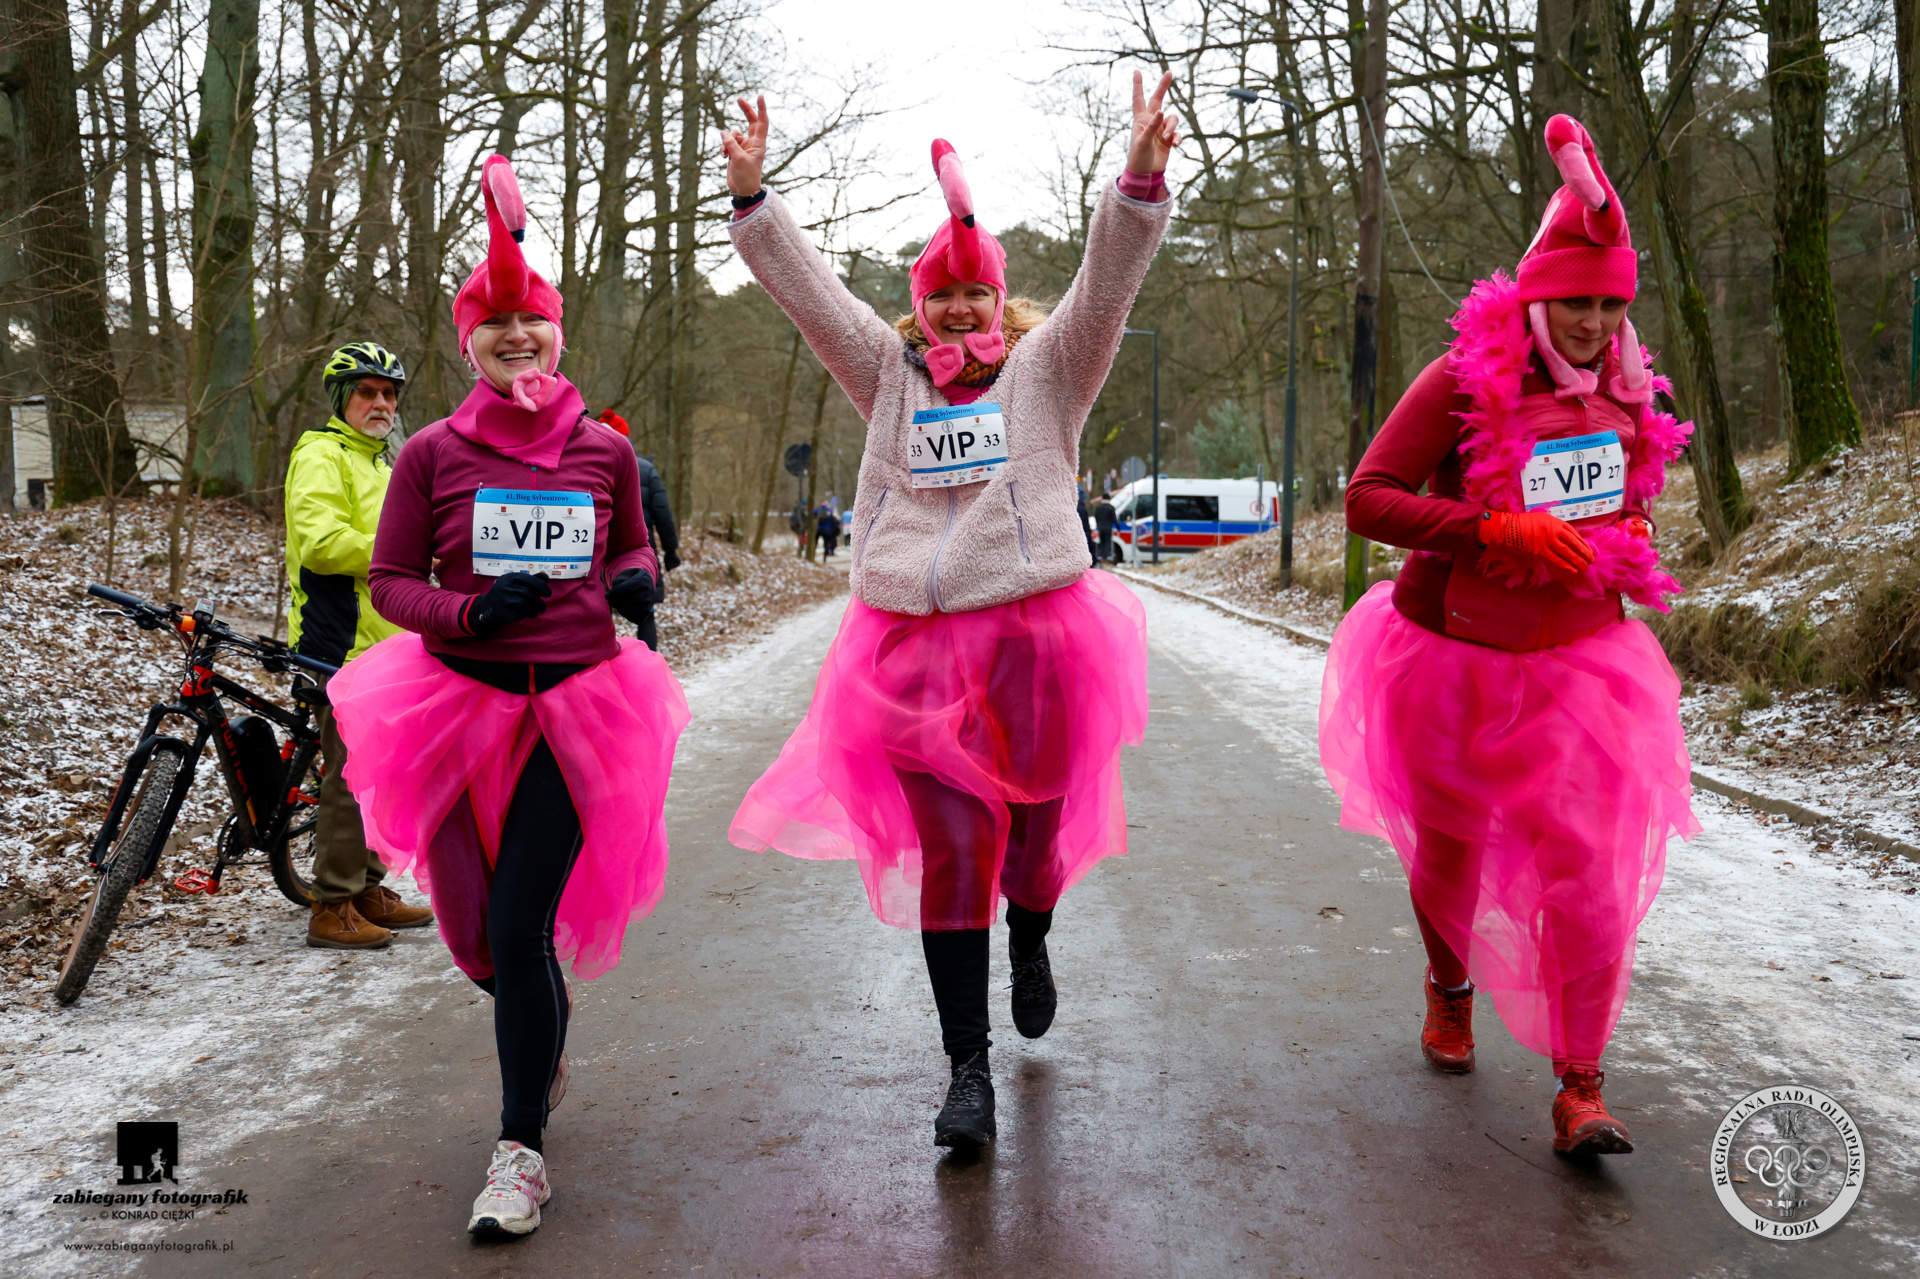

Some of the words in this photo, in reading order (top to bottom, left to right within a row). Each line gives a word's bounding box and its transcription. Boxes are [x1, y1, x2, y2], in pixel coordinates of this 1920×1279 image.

[911, 444, 922, 458] 33
[926, 431, 975, 461] VIP
[984, 433, 1000, 448] 33
[1529, 476, 1546, 491] 27
[1553, 462, 1602, 494] VIP
[1608, 464, 1620, 479] 27
[480, 526, 499, 540] 32
[509, 519, 565, 550] VIP
[572, 529, 588, 543] 32
